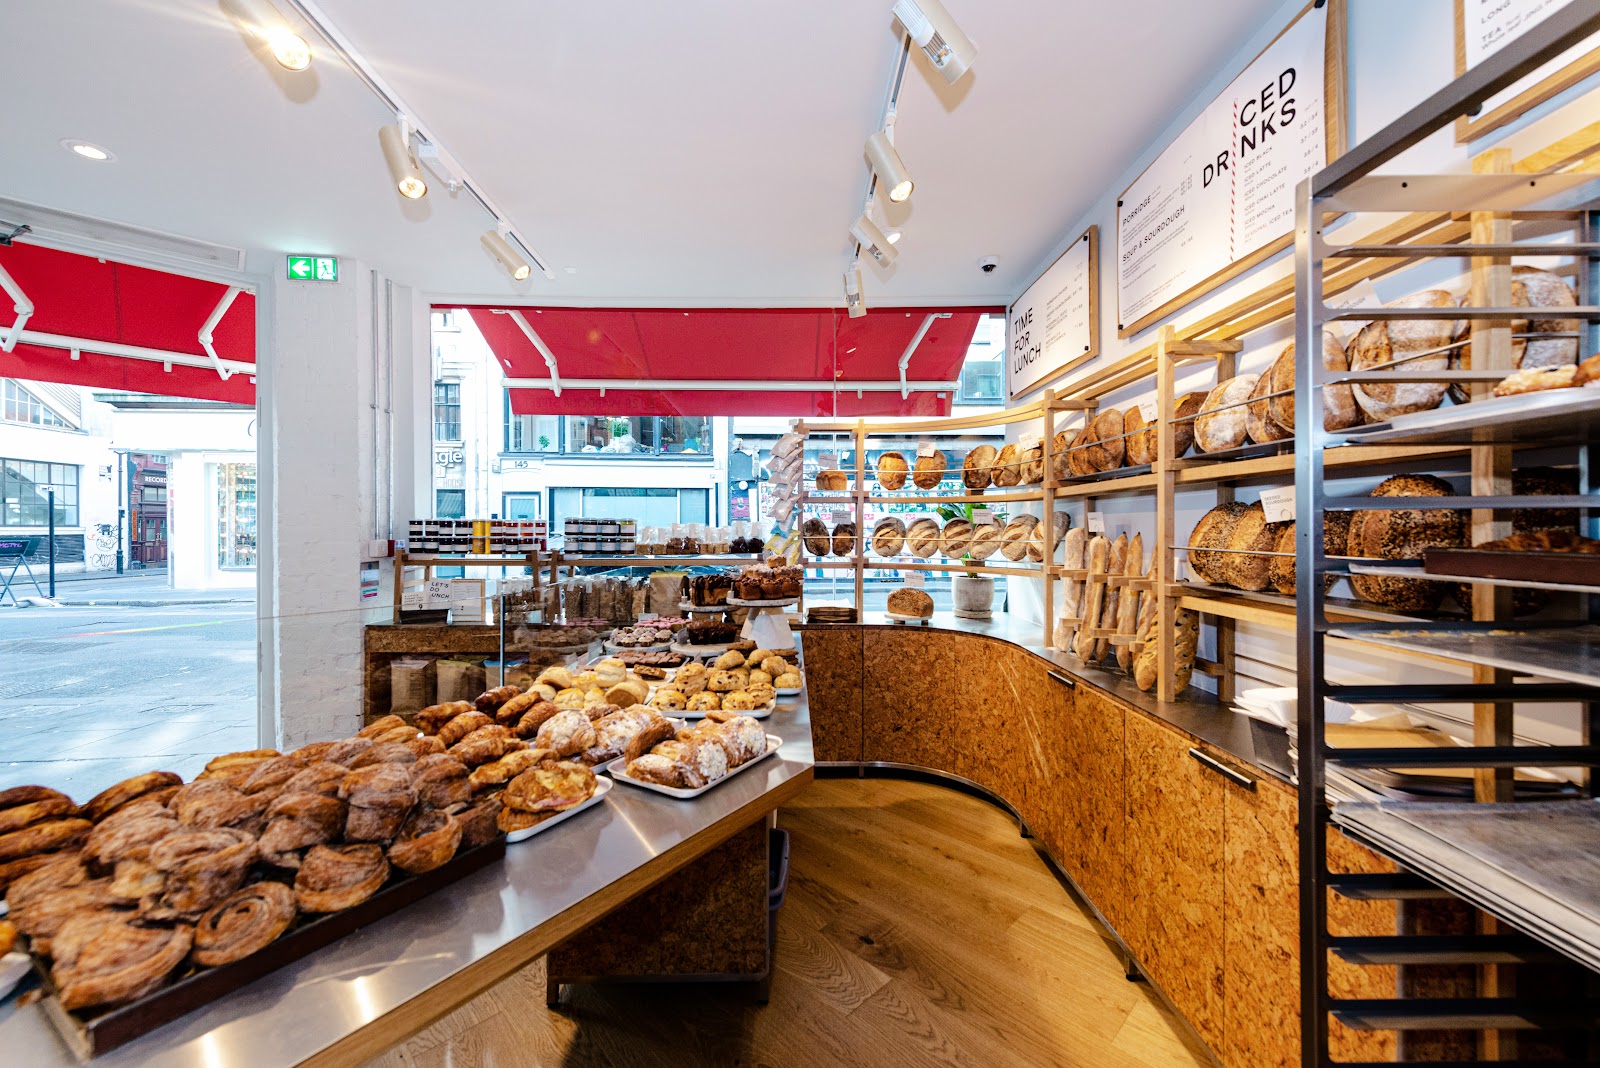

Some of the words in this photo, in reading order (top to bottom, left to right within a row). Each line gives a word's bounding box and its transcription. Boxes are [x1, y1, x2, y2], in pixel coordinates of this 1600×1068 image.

[1481, 0, 1511, 24] LONG
[1482, 27, 1501, 42] TEA
[1244, 158, 1255, 169] ICED
[1256, 146, 1273, 160] BLACK
[1244, 172, 1255, 183] ICED
[1256, 160, 1272, 175] LATTE
[1244, 186, 1255, 197] ICED
[1256, 165, 1288, 189] CHOCOLATE
[1244, 201, 1255, 212] ICED
[1256, 194, 1269, 204] CHAI
[1269, 182, 1286, 196] LATTE
[1122, 195, 1151, 227] PORRIDGE
[1244, 215, 1256, 226] ICED
[1256, 204, 1275, 218] MOCHA
[1268, 214, 1281, 225] ICED
[1282, 208, 1293, 217] TEA
[1122, 244, 1138, 262] SOUP
[1144, 204, 1185, 244] SOURDOUGH
[1014, 307, 1033, 336] TIME
[1014, 331, 1030, 356] FOR
[1014, 342, 1042, 375] LUNCH
